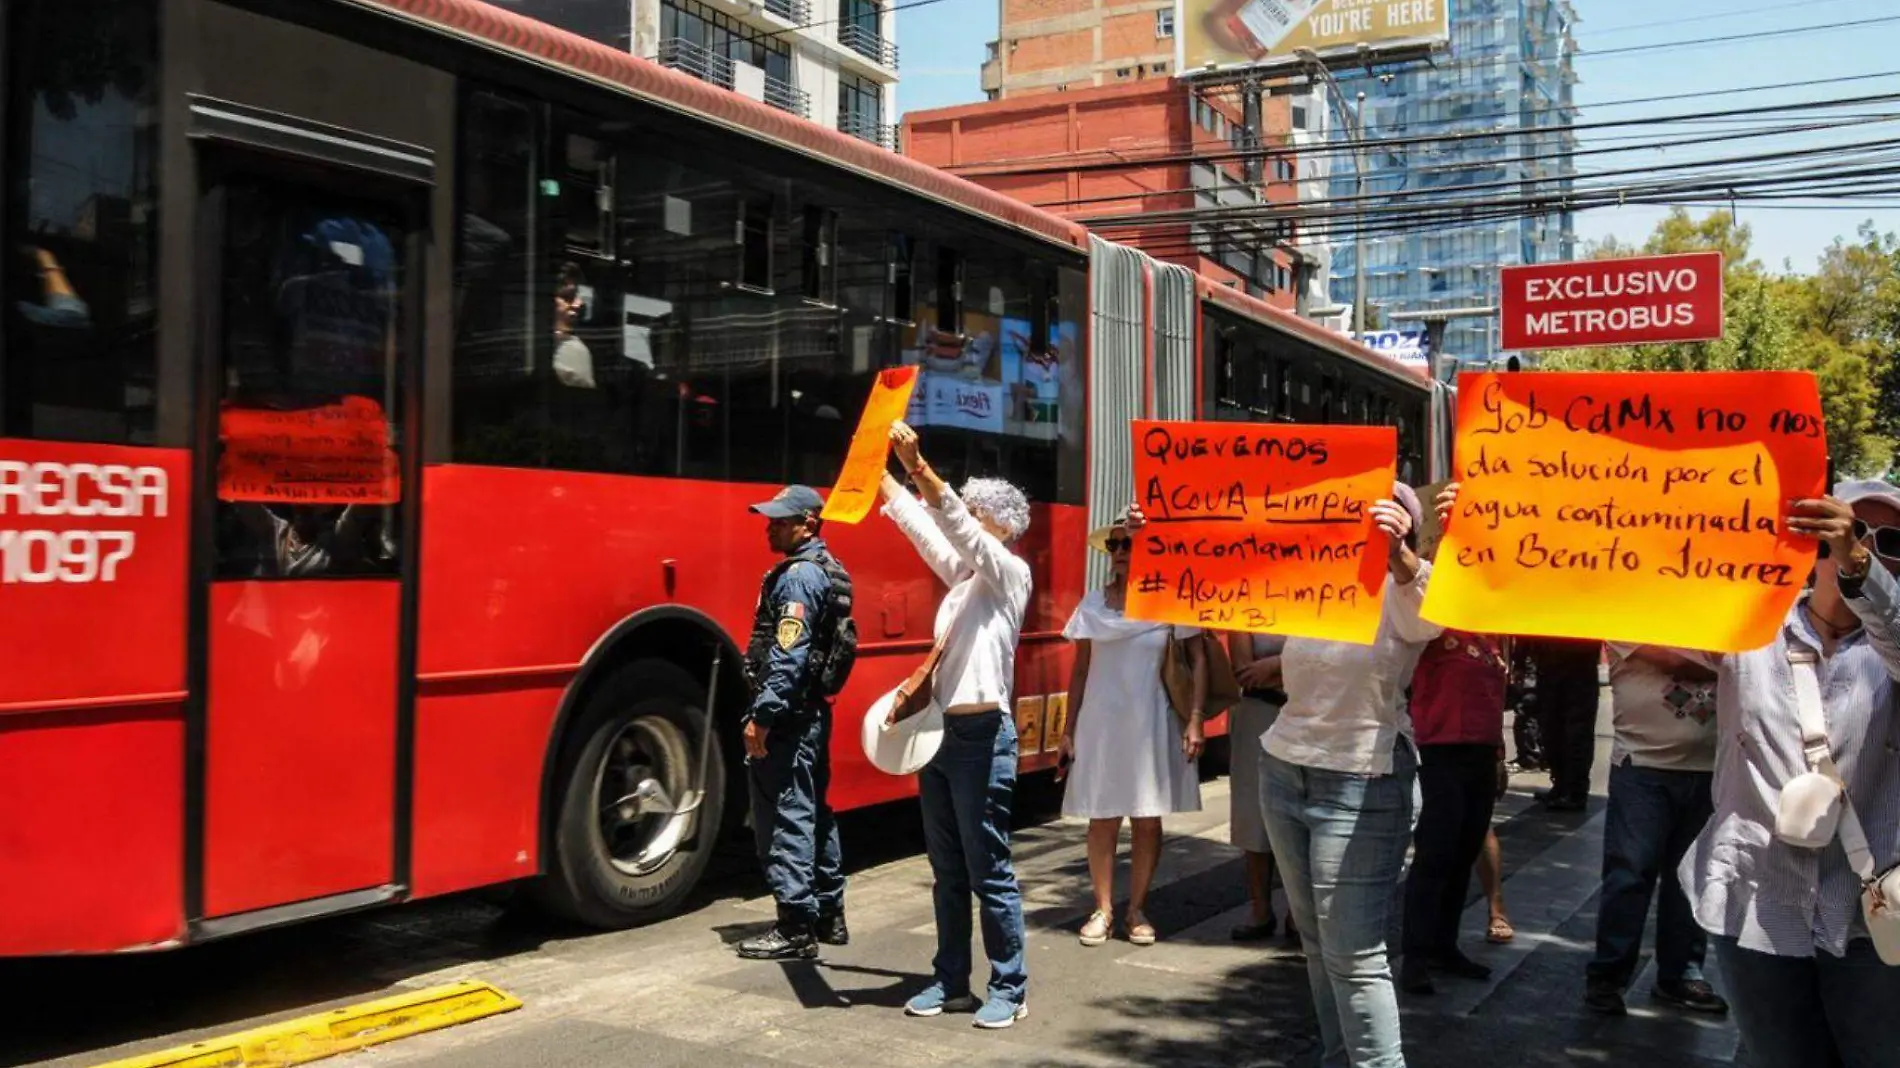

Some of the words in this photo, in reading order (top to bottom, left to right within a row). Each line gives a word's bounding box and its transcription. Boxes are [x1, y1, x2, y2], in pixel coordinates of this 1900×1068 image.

[1308, 7, 1373, 38] YOU'RE
[1387, 0, 1436, 27] HERE
[1525, 268, 1698, 302] EXCLUSIVO
[1525, 303, 1695, 335] METROBUS
[1697, 407, 1747, 432] no
[1770, 408, 1821, 437] nos
[0, 460, 169, 517] RECSA
[1467, 444, 1511, 478] da
[1528, 450, 1649, 483] solución
[1662, 466, 1716, 495] por
[1728, 453, 1763, 486] el
[1464, 500, 1541, 530] agua
[1557, 496, 1778, 537] contaminada
[0, 530, 136, 584] 1097
[1457, 546, 1496, 567] en
[1516, 533, 1640, 572] Benito
[1658, 537, 1793, 587] Juarez
